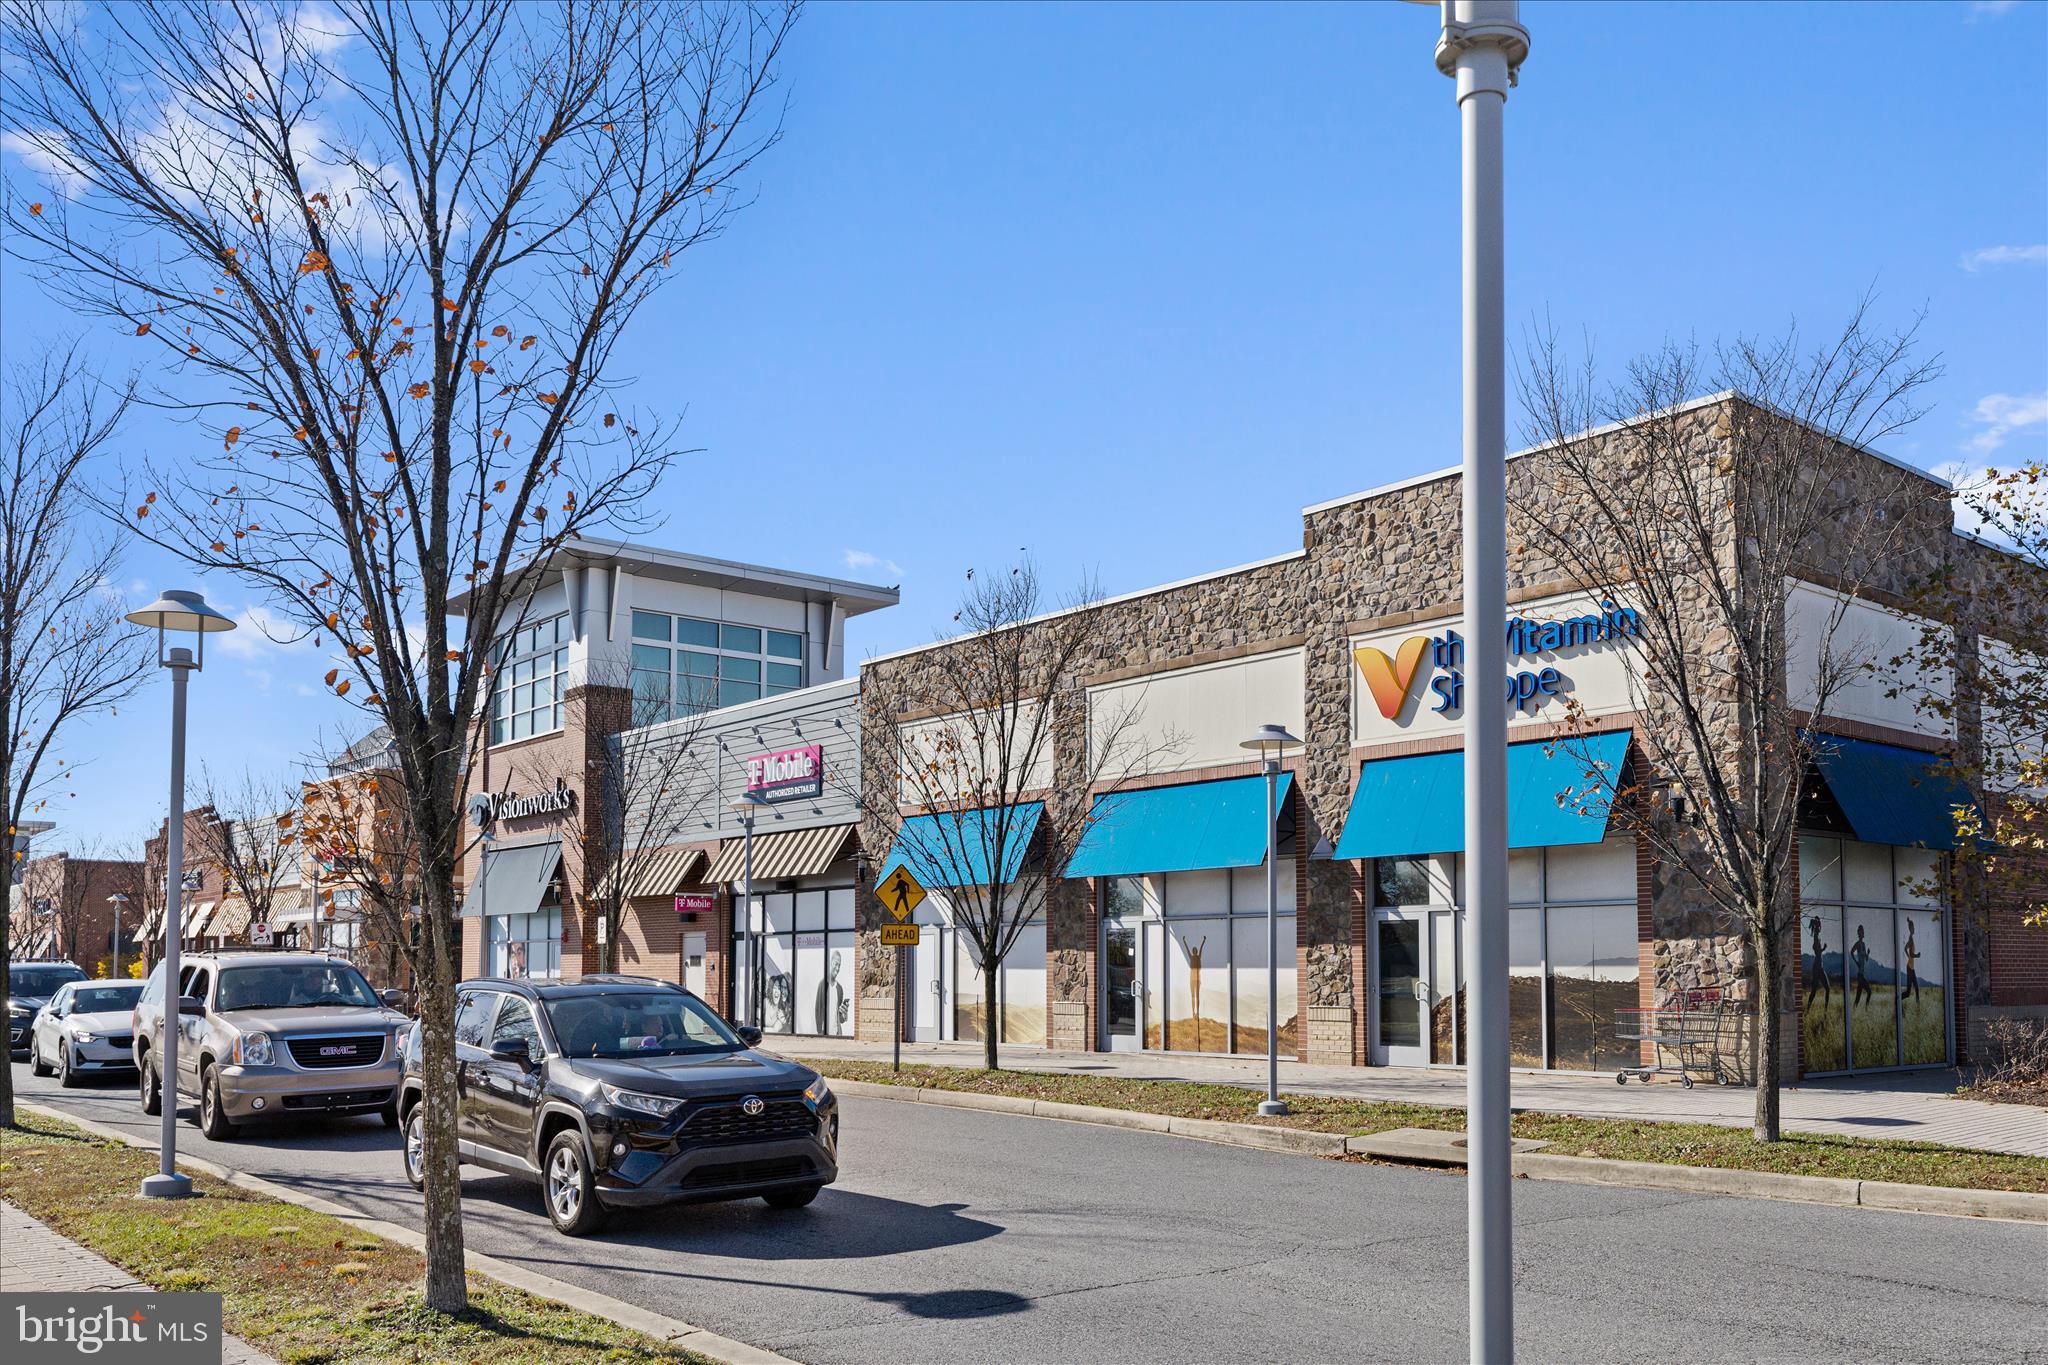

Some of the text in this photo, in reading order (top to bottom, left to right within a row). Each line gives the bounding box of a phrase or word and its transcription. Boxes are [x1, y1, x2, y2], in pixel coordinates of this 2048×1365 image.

[765, 783, 816, 799] AUTHORIZED RETAILER
[489, 778, 570, 820] Visionworks
[885, 929, 915, 940] AHEAD
[320, 1045, 357, 1056] GMC
